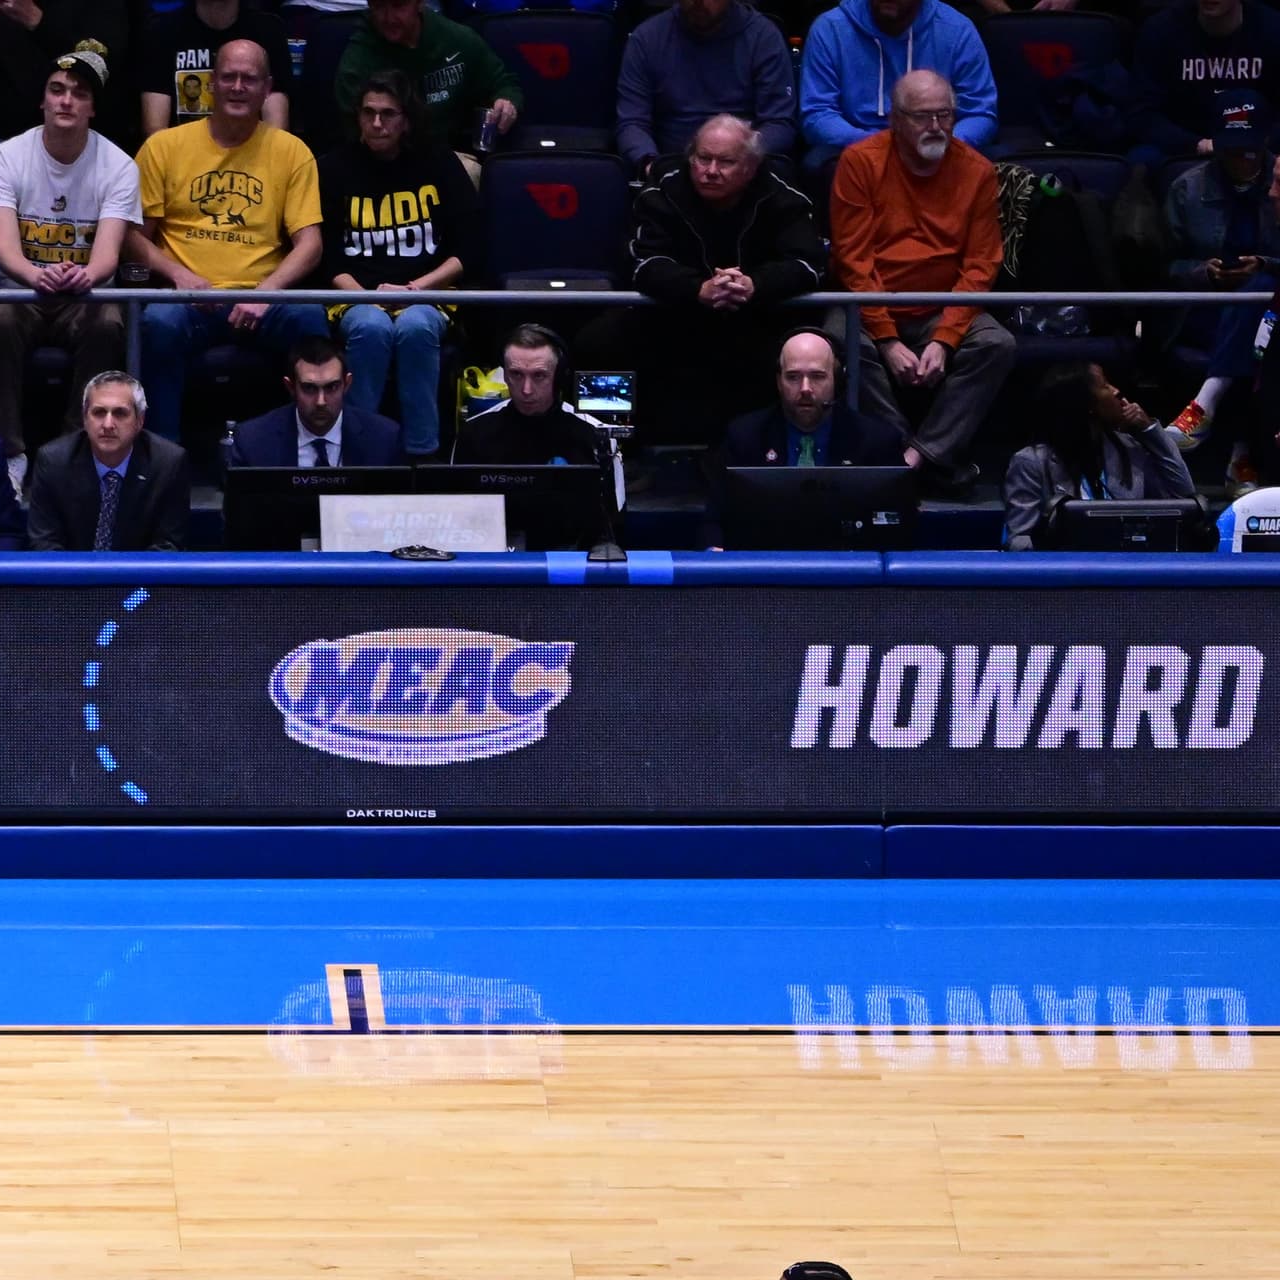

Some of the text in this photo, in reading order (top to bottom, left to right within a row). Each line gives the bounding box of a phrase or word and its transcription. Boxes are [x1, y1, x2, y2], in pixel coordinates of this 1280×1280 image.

[1182, 57, 1263, 81] HOWARD
[190, 170, 263, 204] UMBC
[185, 229, 255, 245] BASKETBALL
[296, 643, 573, 717] MEAC
[789, 645, 1265, 749] HOWARD
[346, 808, 436, 818] DAKTRONICS
